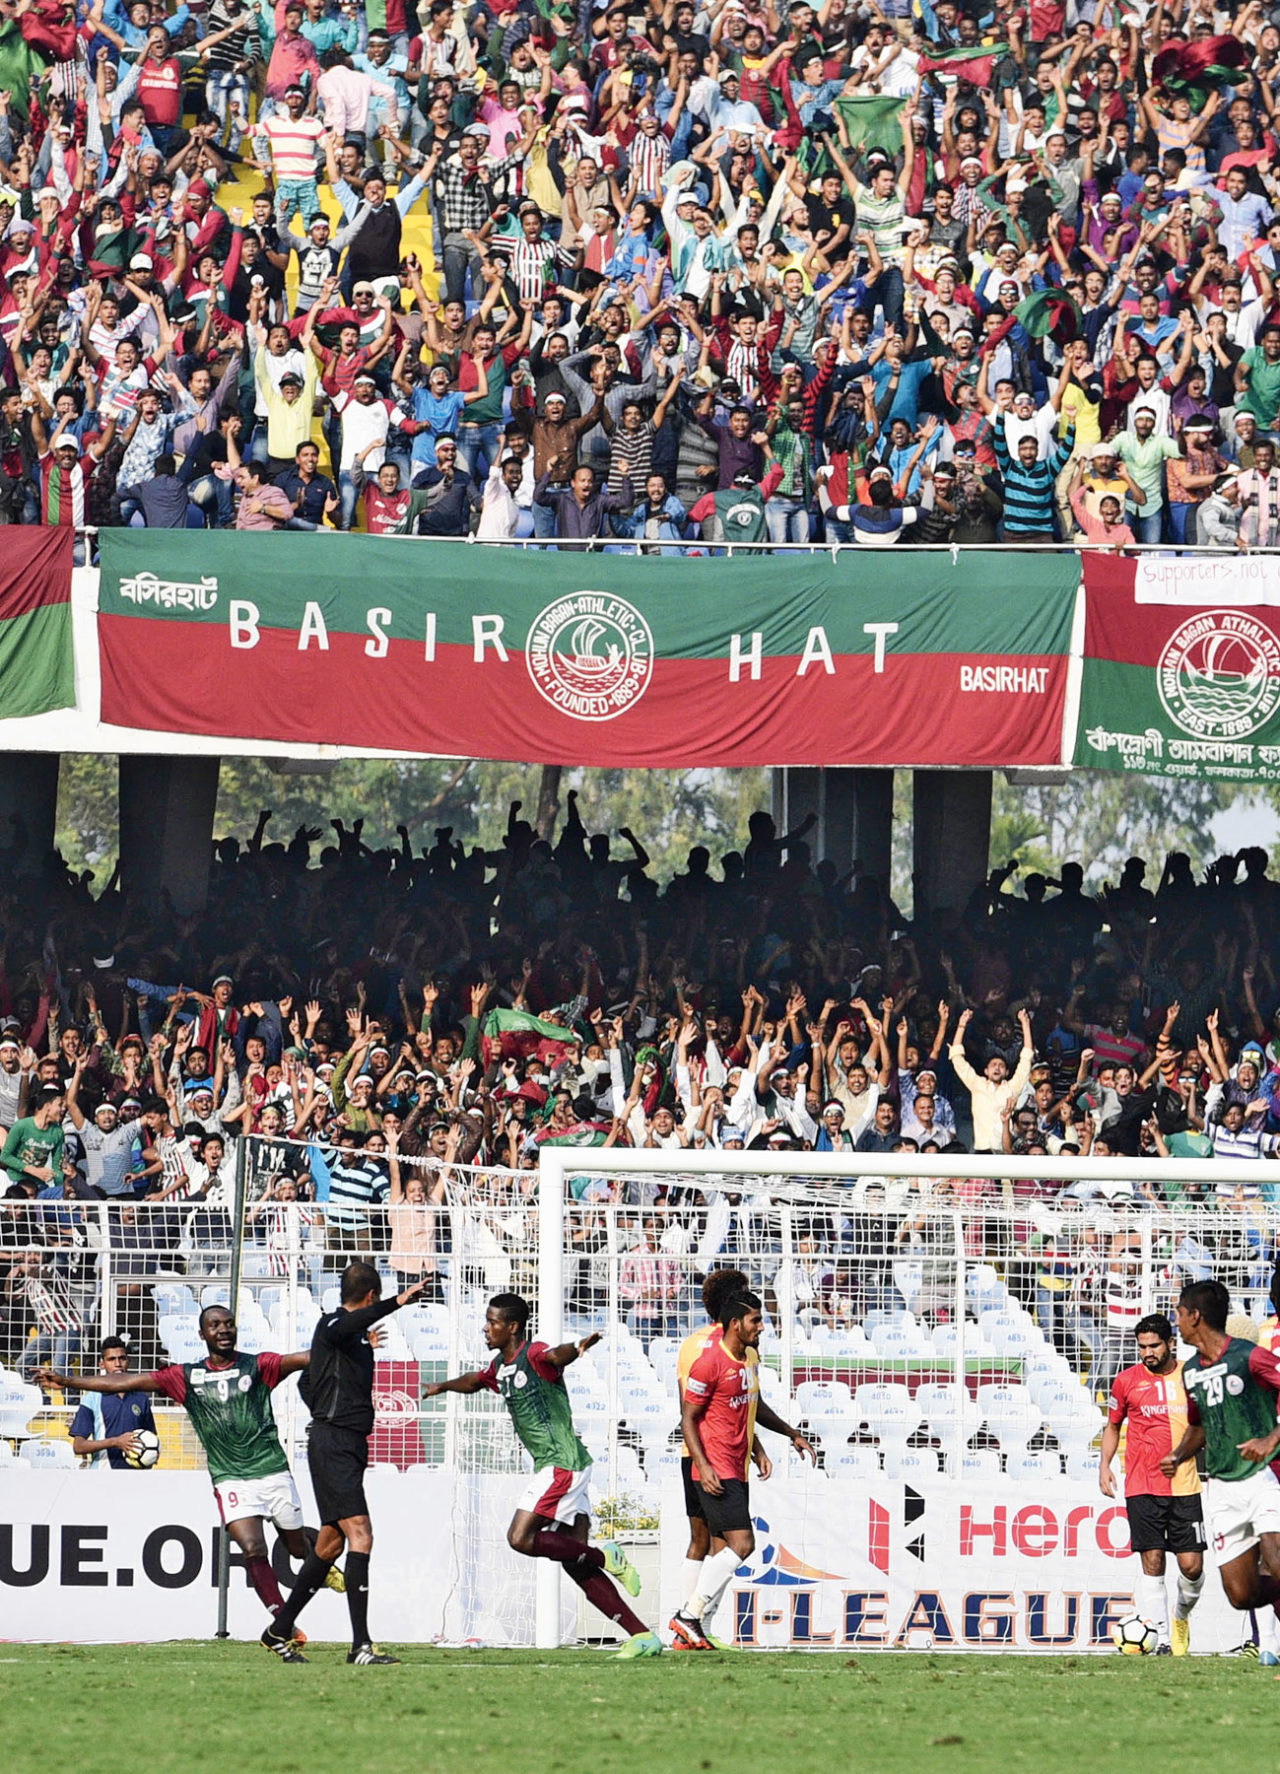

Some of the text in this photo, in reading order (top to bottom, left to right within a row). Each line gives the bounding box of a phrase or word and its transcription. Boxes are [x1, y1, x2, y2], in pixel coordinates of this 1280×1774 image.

[120, 571, 218, 611] বসিরহাট
[531, 597, 648, 678] MOHUN BAGAN ATHLETIC CLUB
[960, 664, 1049, 695] BASIRHAT
[1162, 647, 1182, 699] MOHAN
[1175, 617, 1217, 649] BAGAN
[1258, 675, 1280, 714] CLUB
[545, 679, 640, 715] FOUNDED 1889
[217, 1380, 229, 1402] 9
[1154, 1381, 1177, 1401] 16
[1203, 1376, 1223, 1407] 29
[228, 1491, 239, 1508] 9
[960, 1504, 1132, 1559] Hero
[731, 1589, 1137, 1648] I-LEAGUE
